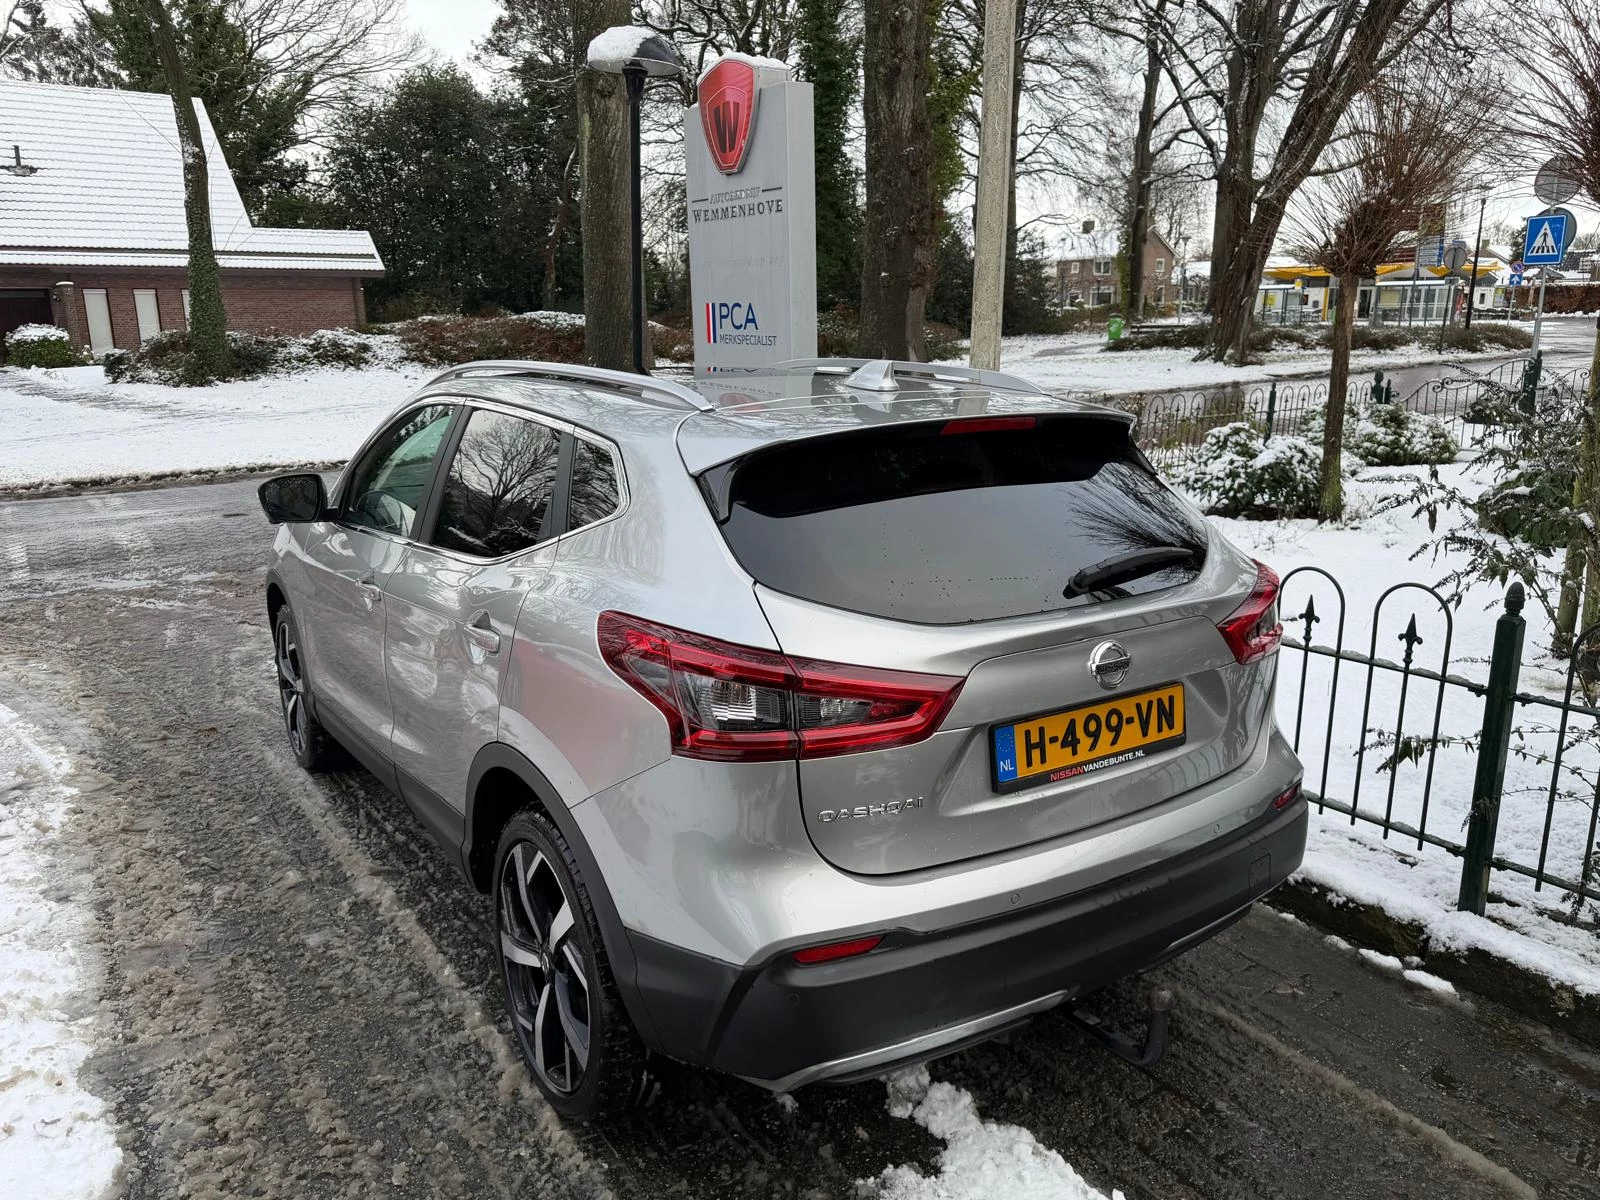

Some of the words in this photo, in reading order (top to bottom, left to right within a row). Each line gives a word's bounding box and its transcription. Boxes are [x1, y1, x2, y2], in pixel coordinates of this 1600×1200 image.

[692, 199, 783, 224] WEMMENHOVE
[719, 302, 759, 331] PCA
[719, 334, 777, 347] MERKSPECIALIST
[1096, 659, 1129, 673] NISSAN
[1024, 694, 1175, 768] H-499-VN
[1000, 759, 1015, 773] NL
[1050, 749, 1146, 782] NISSANVANDEBUNTE.NL
[818, 796, 924, 822] QASHQAI
